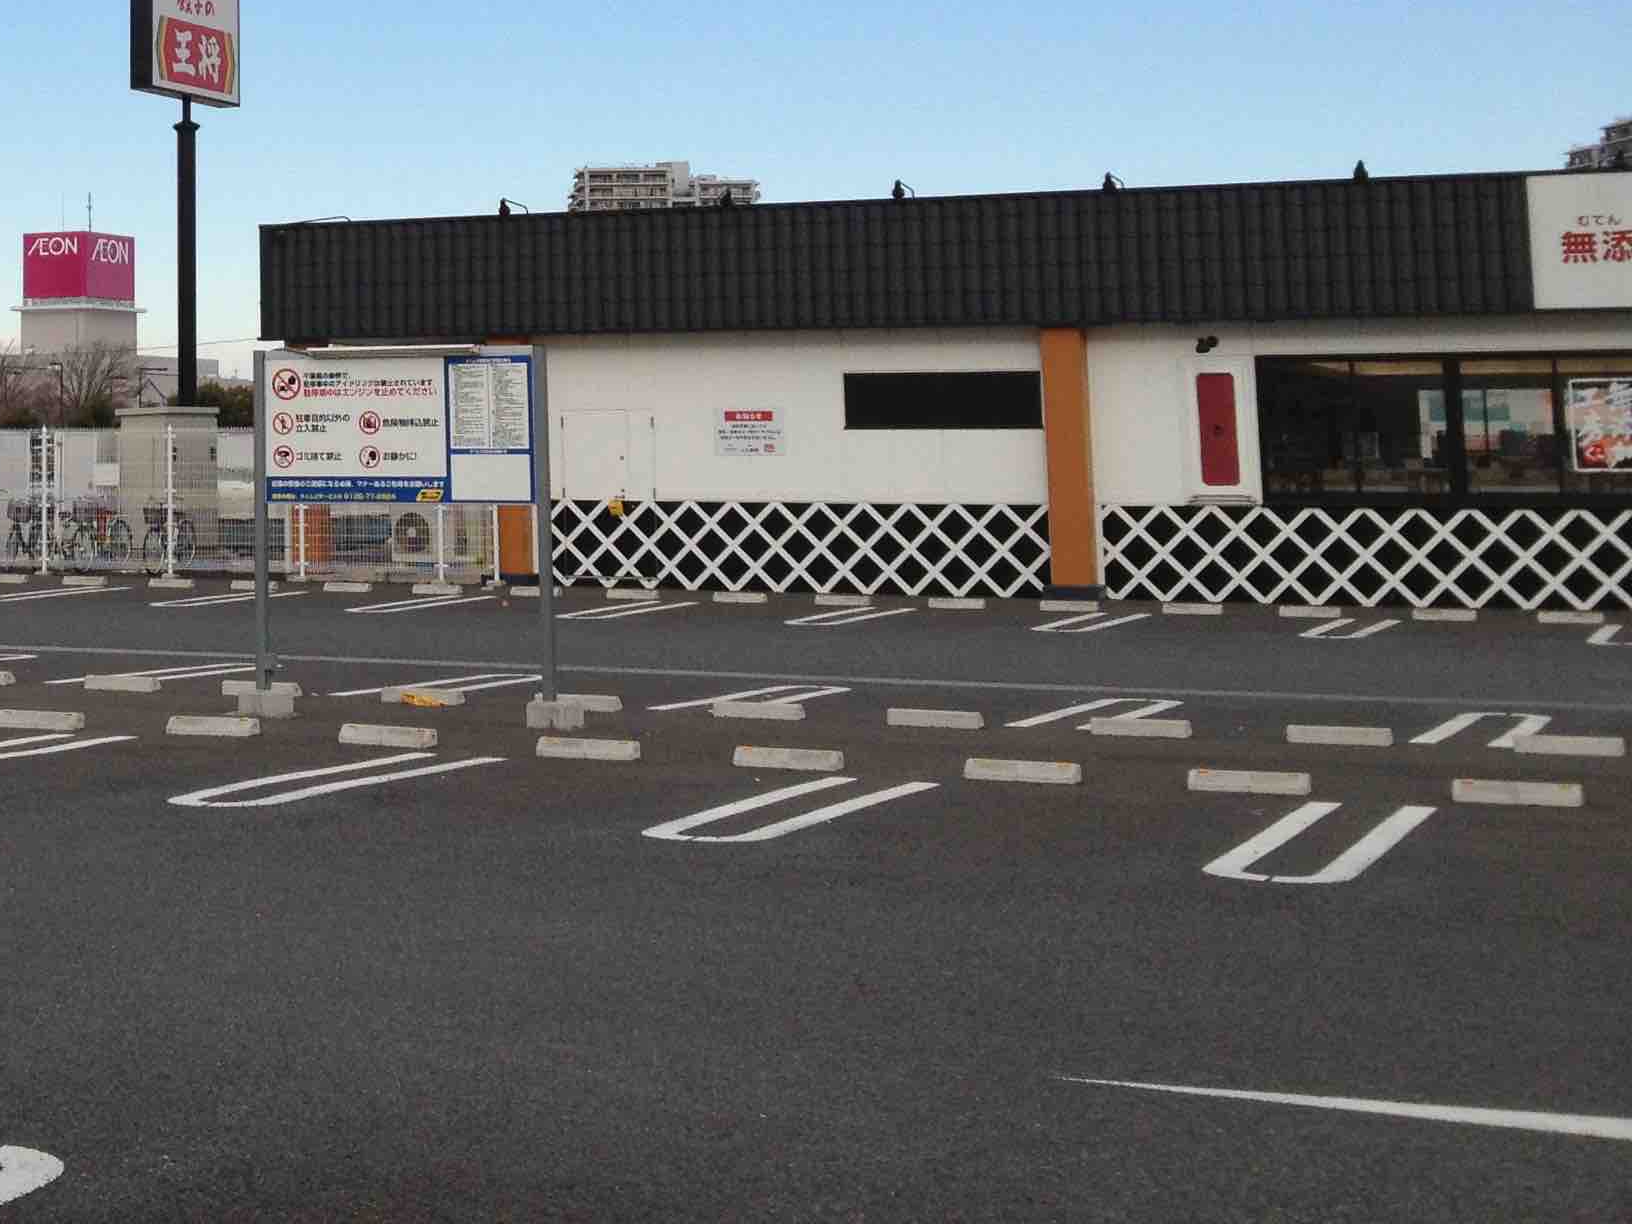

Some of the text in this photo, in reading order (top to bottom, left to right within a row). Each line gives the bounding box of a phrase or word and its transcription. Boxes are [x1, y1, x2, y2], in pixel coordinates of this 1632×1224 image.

[172, 27, 222, 86] 王将
[1576, 214, 1623, 226] むてん
